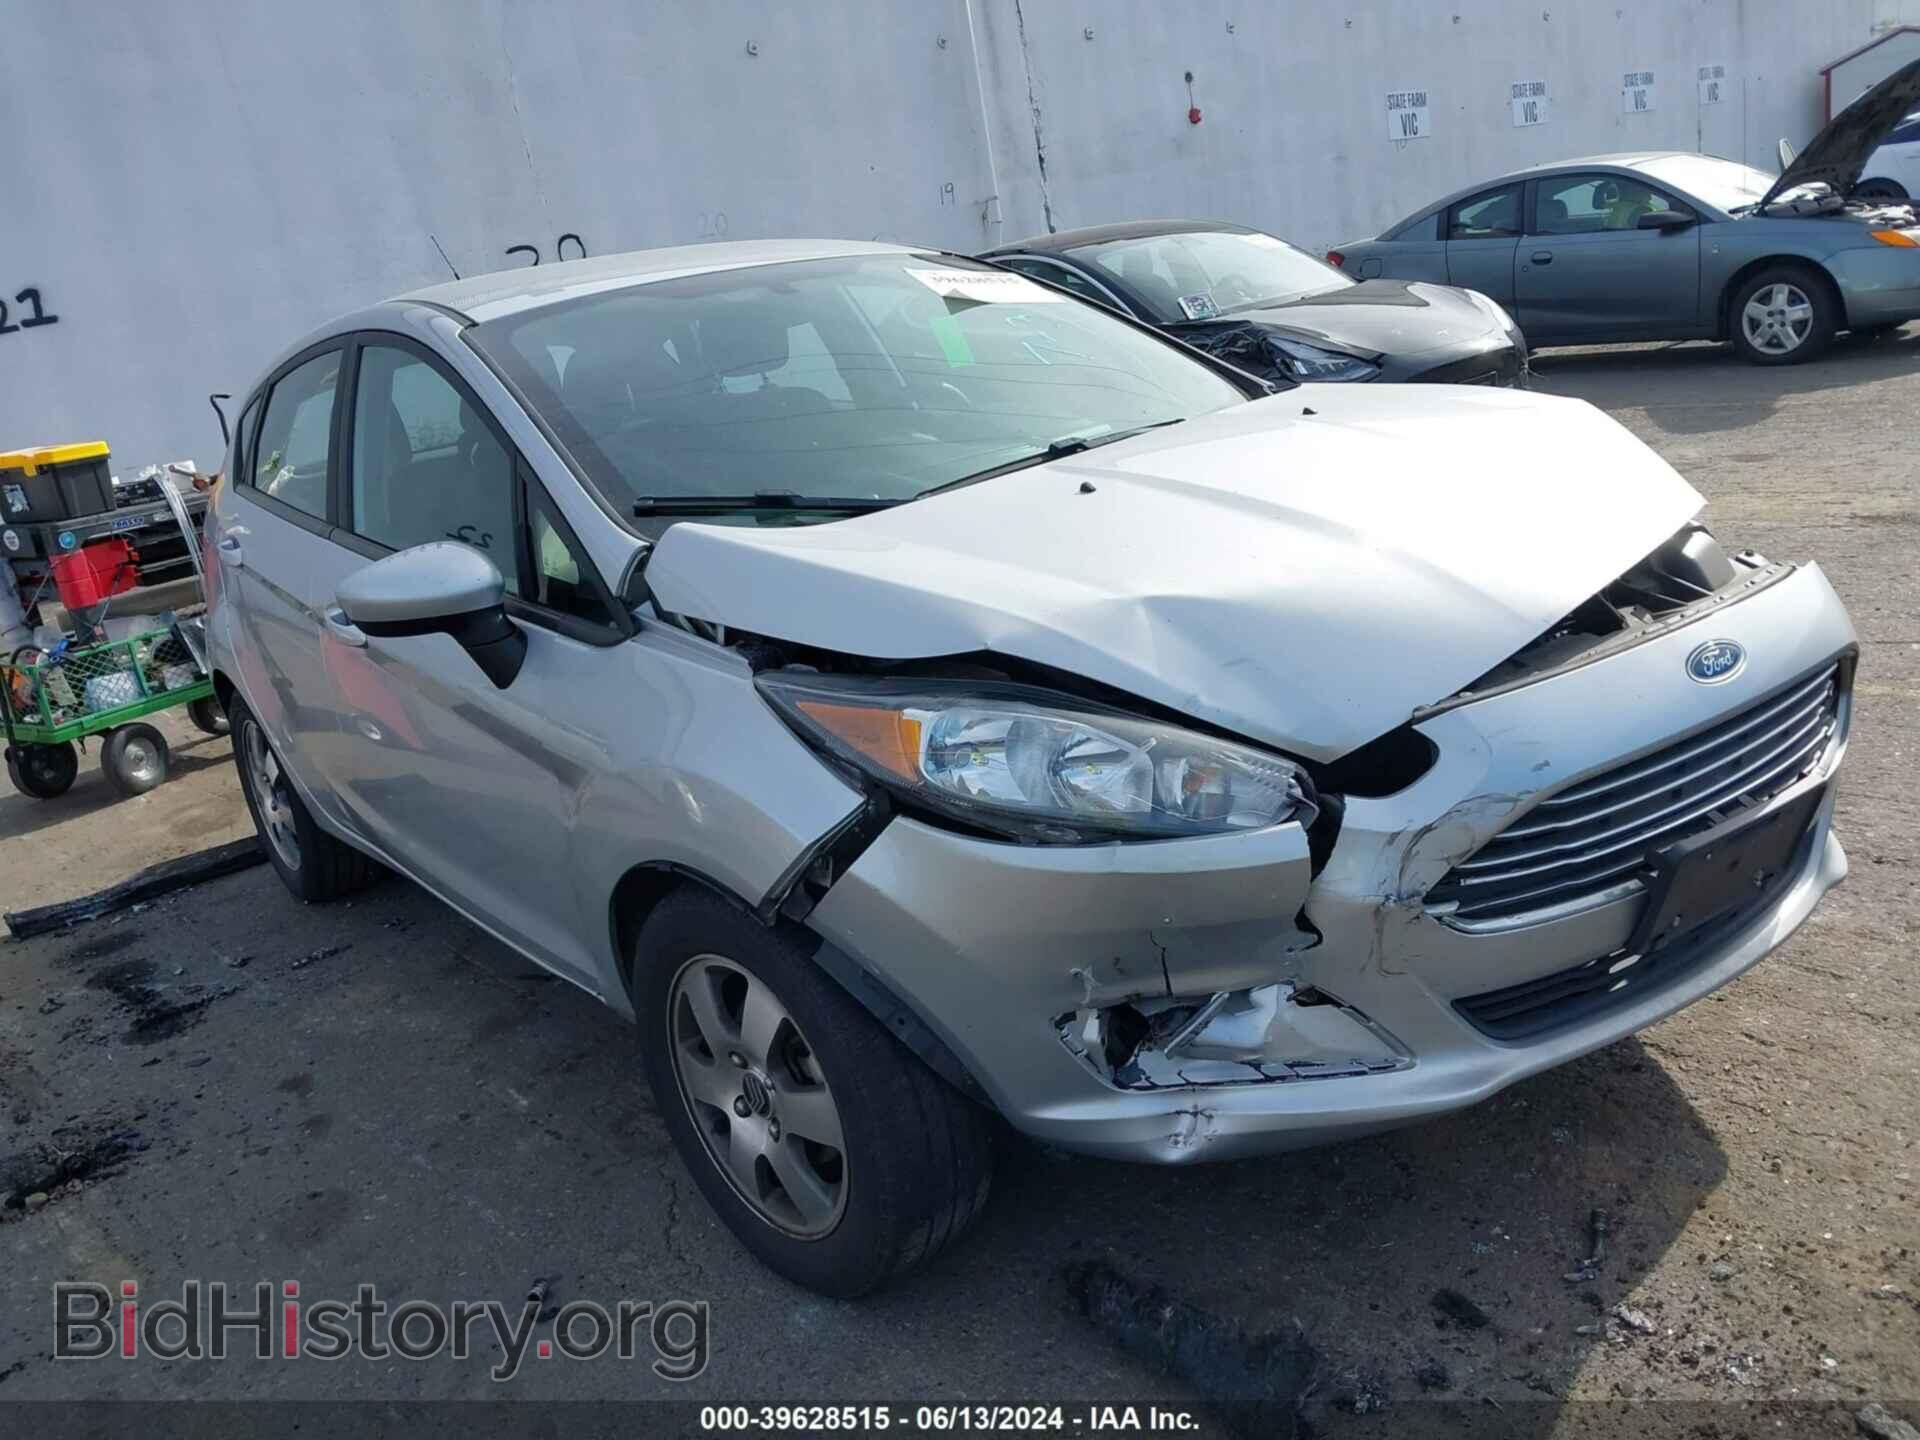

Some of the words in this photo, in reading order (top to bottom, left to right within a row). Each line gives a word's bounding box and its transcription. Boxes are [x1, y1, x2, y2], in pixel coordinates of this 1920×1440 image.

[1387, 94, 1407, 110] STATE
[1407, 92, 1428, 108] FARM
[1512, 83, 1528, 99] STATE
[1529, 81, 1546, 97] FARM
[1632, 88, 1648, 110] VIC
[1522, 101, 1538, 123] VIC
[1400, 112, 1419, 137] VIC
[939, 182, 956, 206] 19
